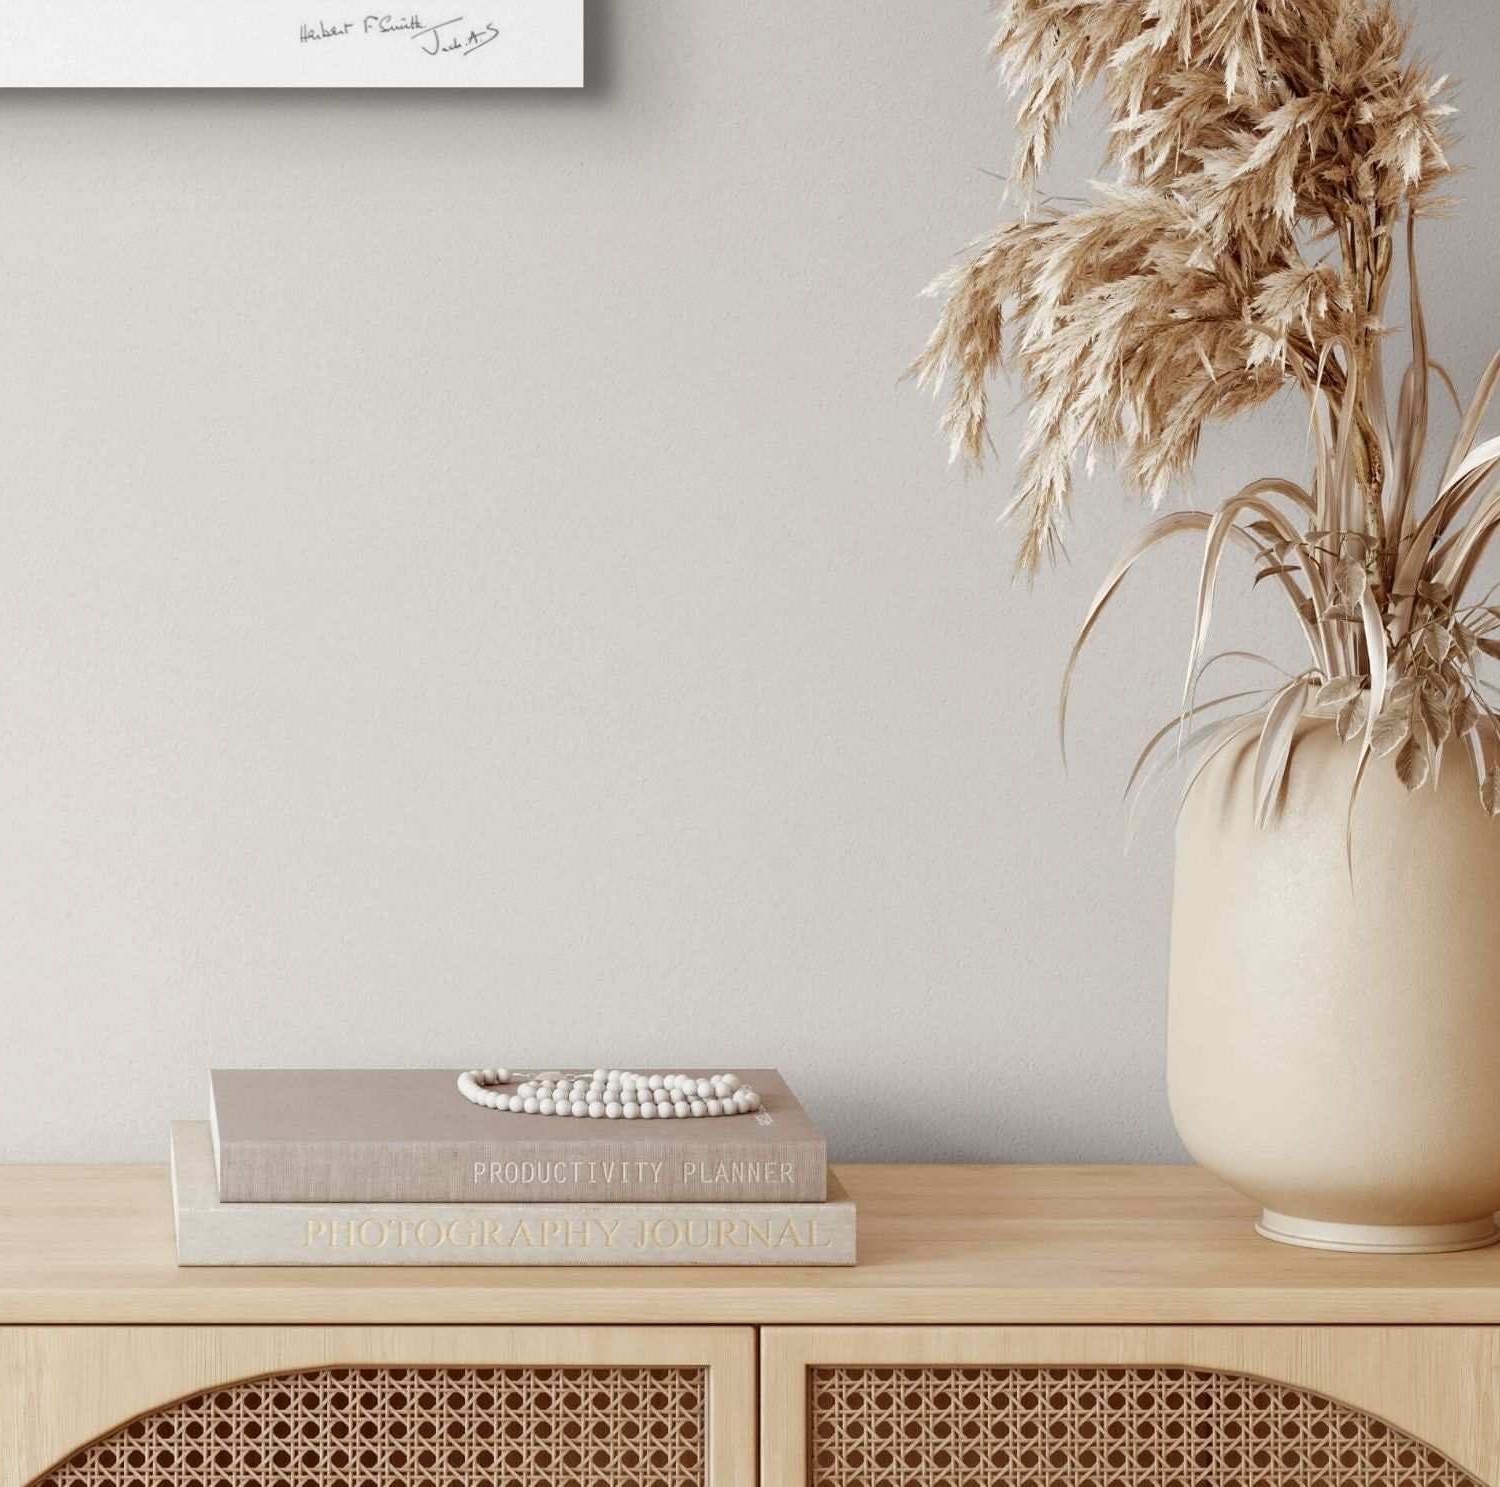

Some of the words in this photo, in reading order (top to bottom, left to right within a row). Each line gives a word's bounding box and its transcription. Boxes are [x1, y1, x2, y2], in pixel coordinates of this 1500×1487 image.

[473, 1161, 663, 1184] PRODUCTIVITY
[683, 1161, 795, 1184] PLANNER
[303, 1218, 624, 1248] PHOTOGRAPHY
[634, 1218, 833, 1248] JOURNAL
